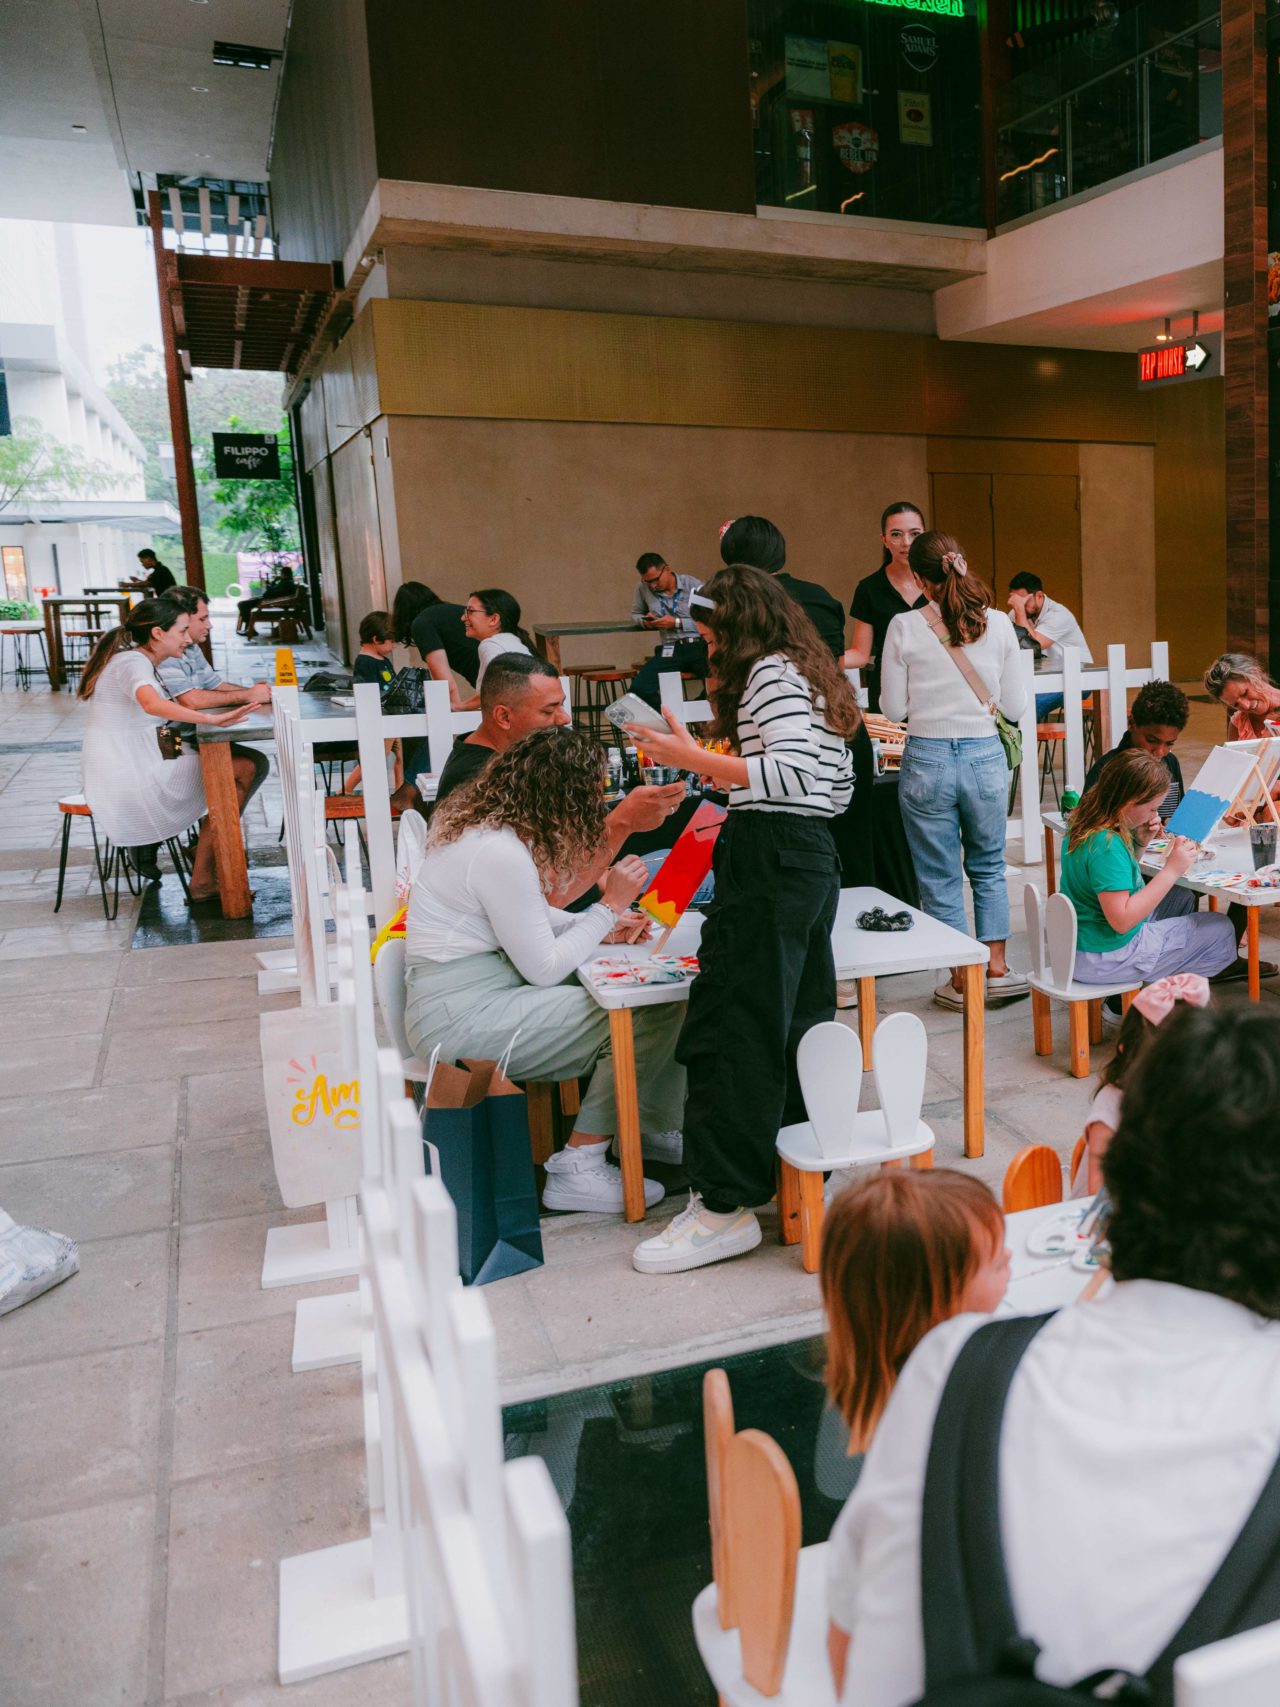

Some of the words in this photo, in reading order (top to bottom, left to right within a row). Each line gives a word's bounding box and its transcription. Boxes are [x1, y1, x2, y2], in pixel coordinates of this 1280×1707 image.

[900, 32, 937, 48] SAMUEL
[904, 43, 936, 57] ADAMS
[839, 148, 862, 161] REBEL
[864, 149, 878, 162] IPA
[1141, 351, 1156, 381] TAP
[1157, 345, 1185, 379] HOUSE
[223, 446, 269, 457] FILIPPO
